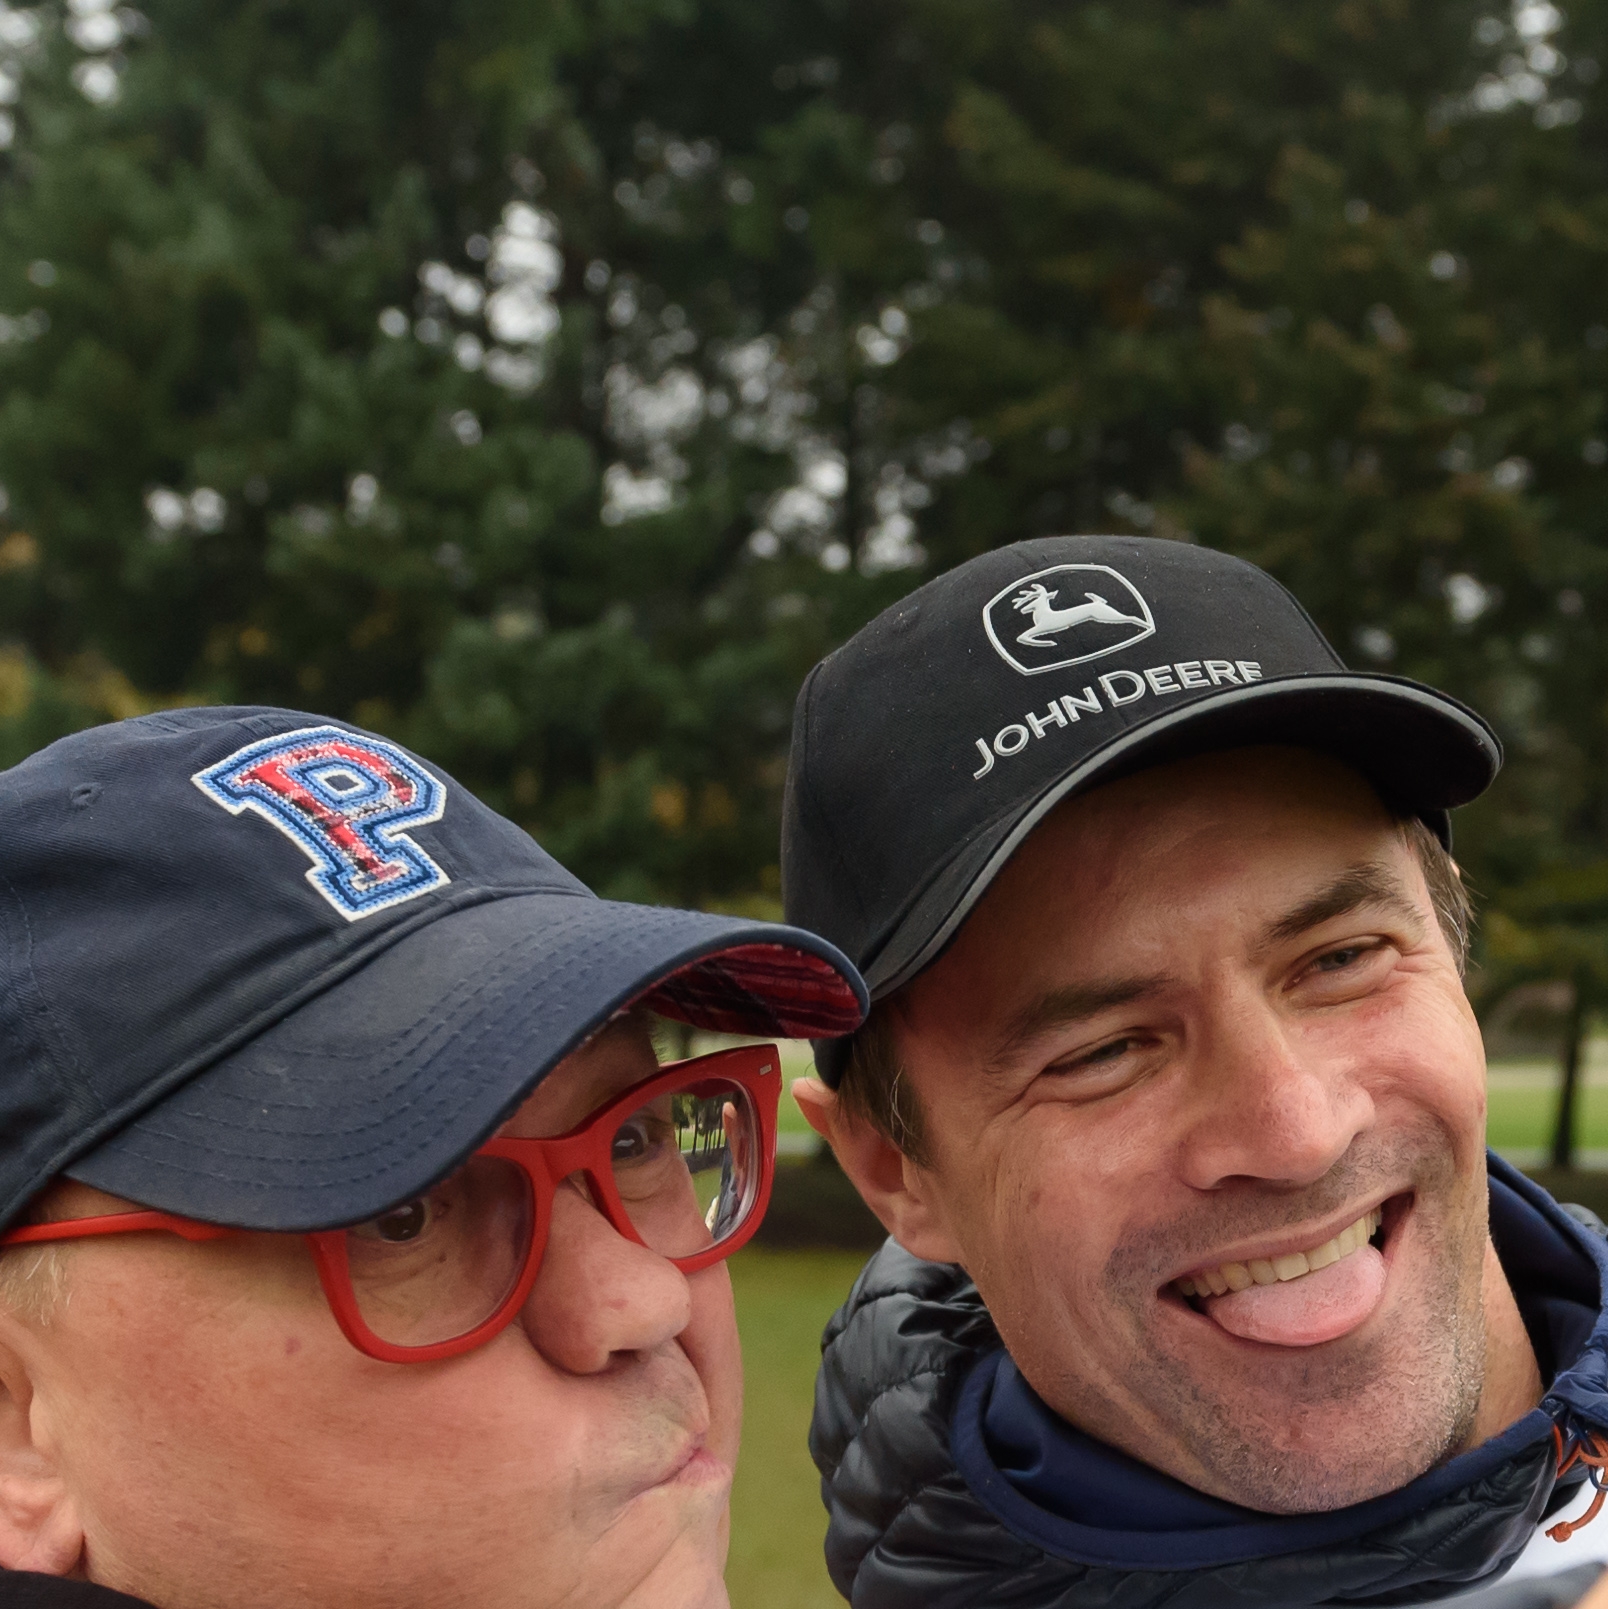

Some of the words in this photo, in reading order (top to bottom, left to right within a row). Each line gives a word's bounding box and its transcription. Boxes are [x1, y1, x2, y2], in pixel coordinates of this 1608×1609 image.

[972, 685, 1103, 780] JOHN
[1098, 658, 1263, 708] DEERE
[190, 724, 452, 922] P
